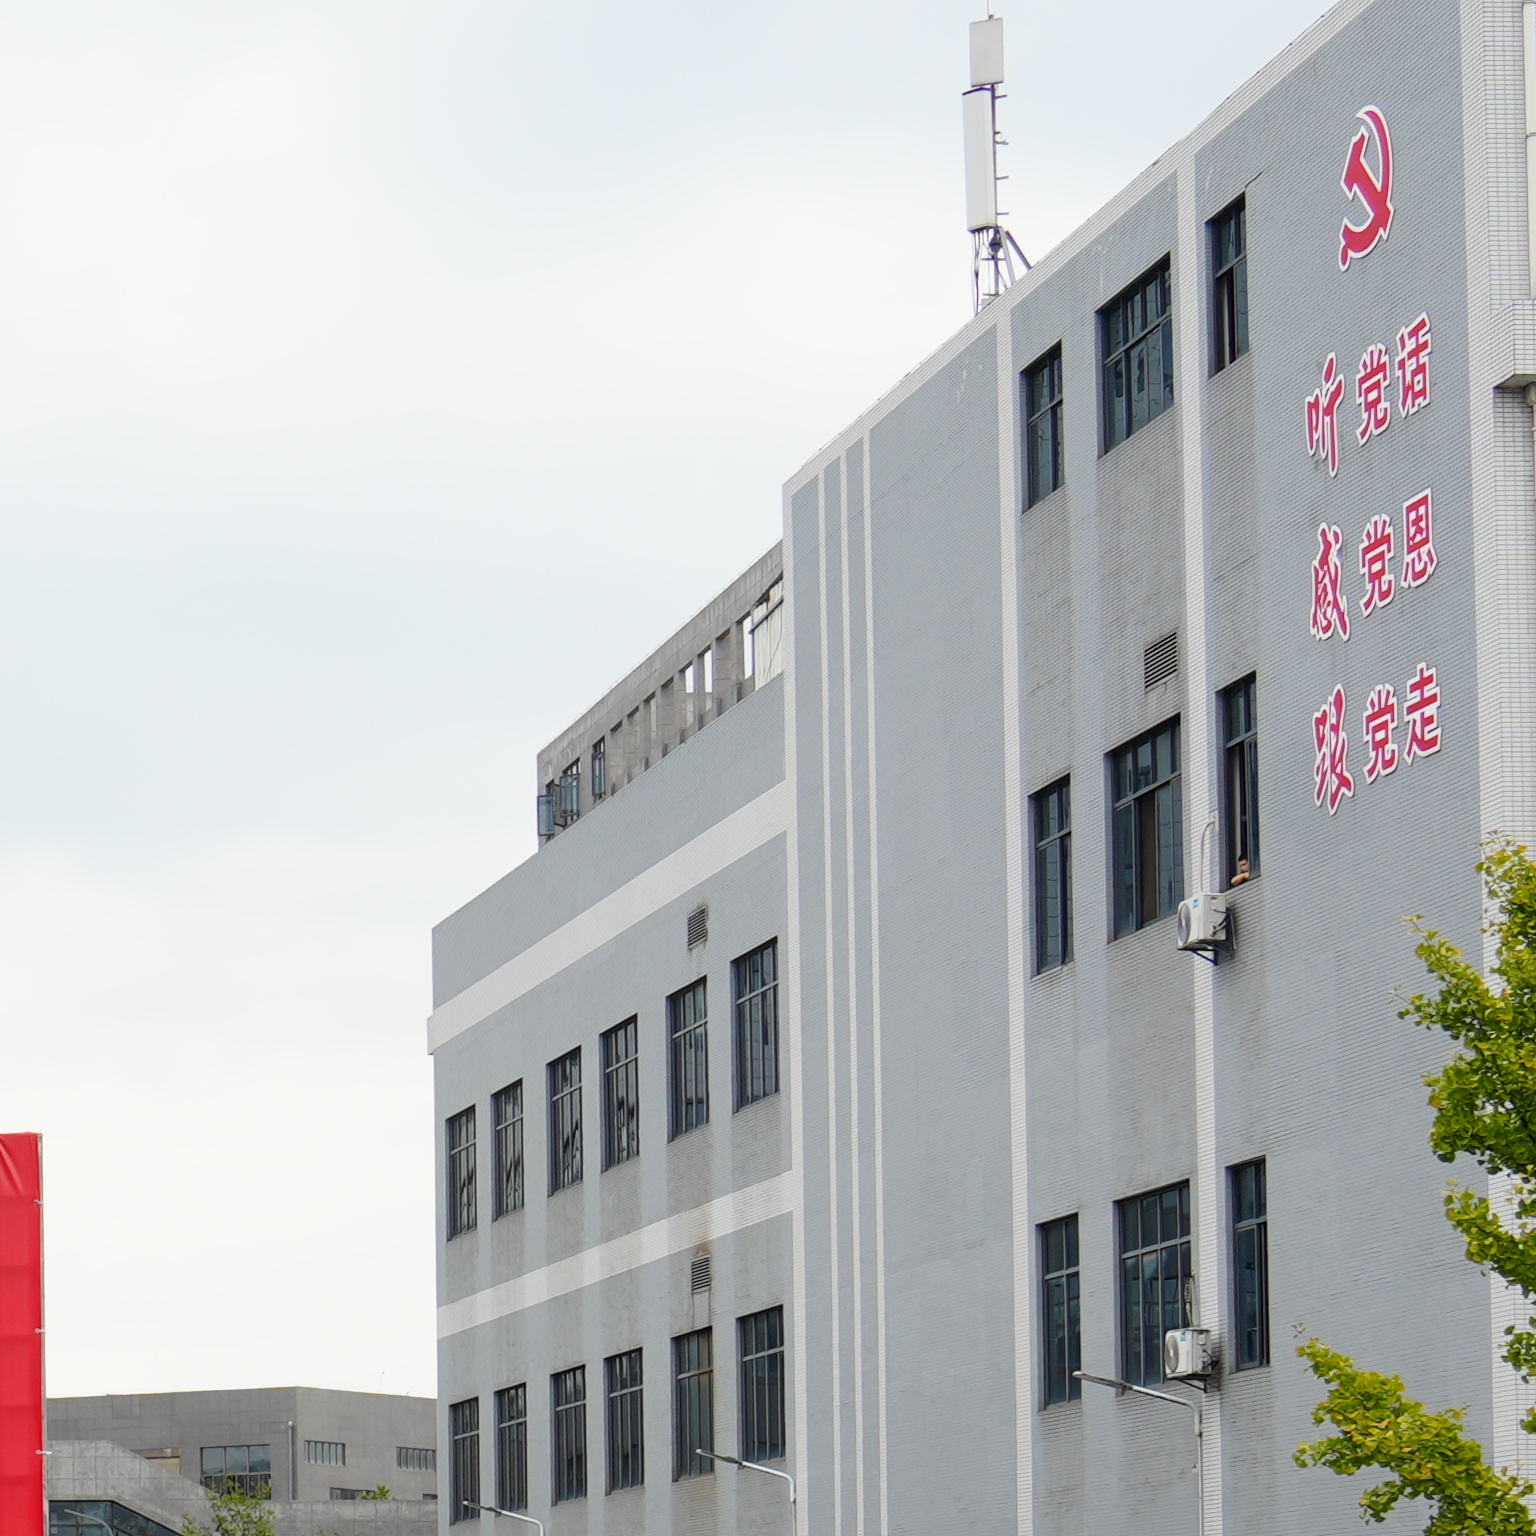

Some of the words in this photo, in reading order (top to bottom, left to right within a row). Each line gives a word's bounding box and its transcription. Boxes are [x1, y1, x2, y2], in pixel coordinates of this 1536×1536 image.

[1305, 311, 1432, 478] 听党话
[1310, 488, 1438, 642] 感党恩
[1313, 662, 1442, 817] 跟党走
